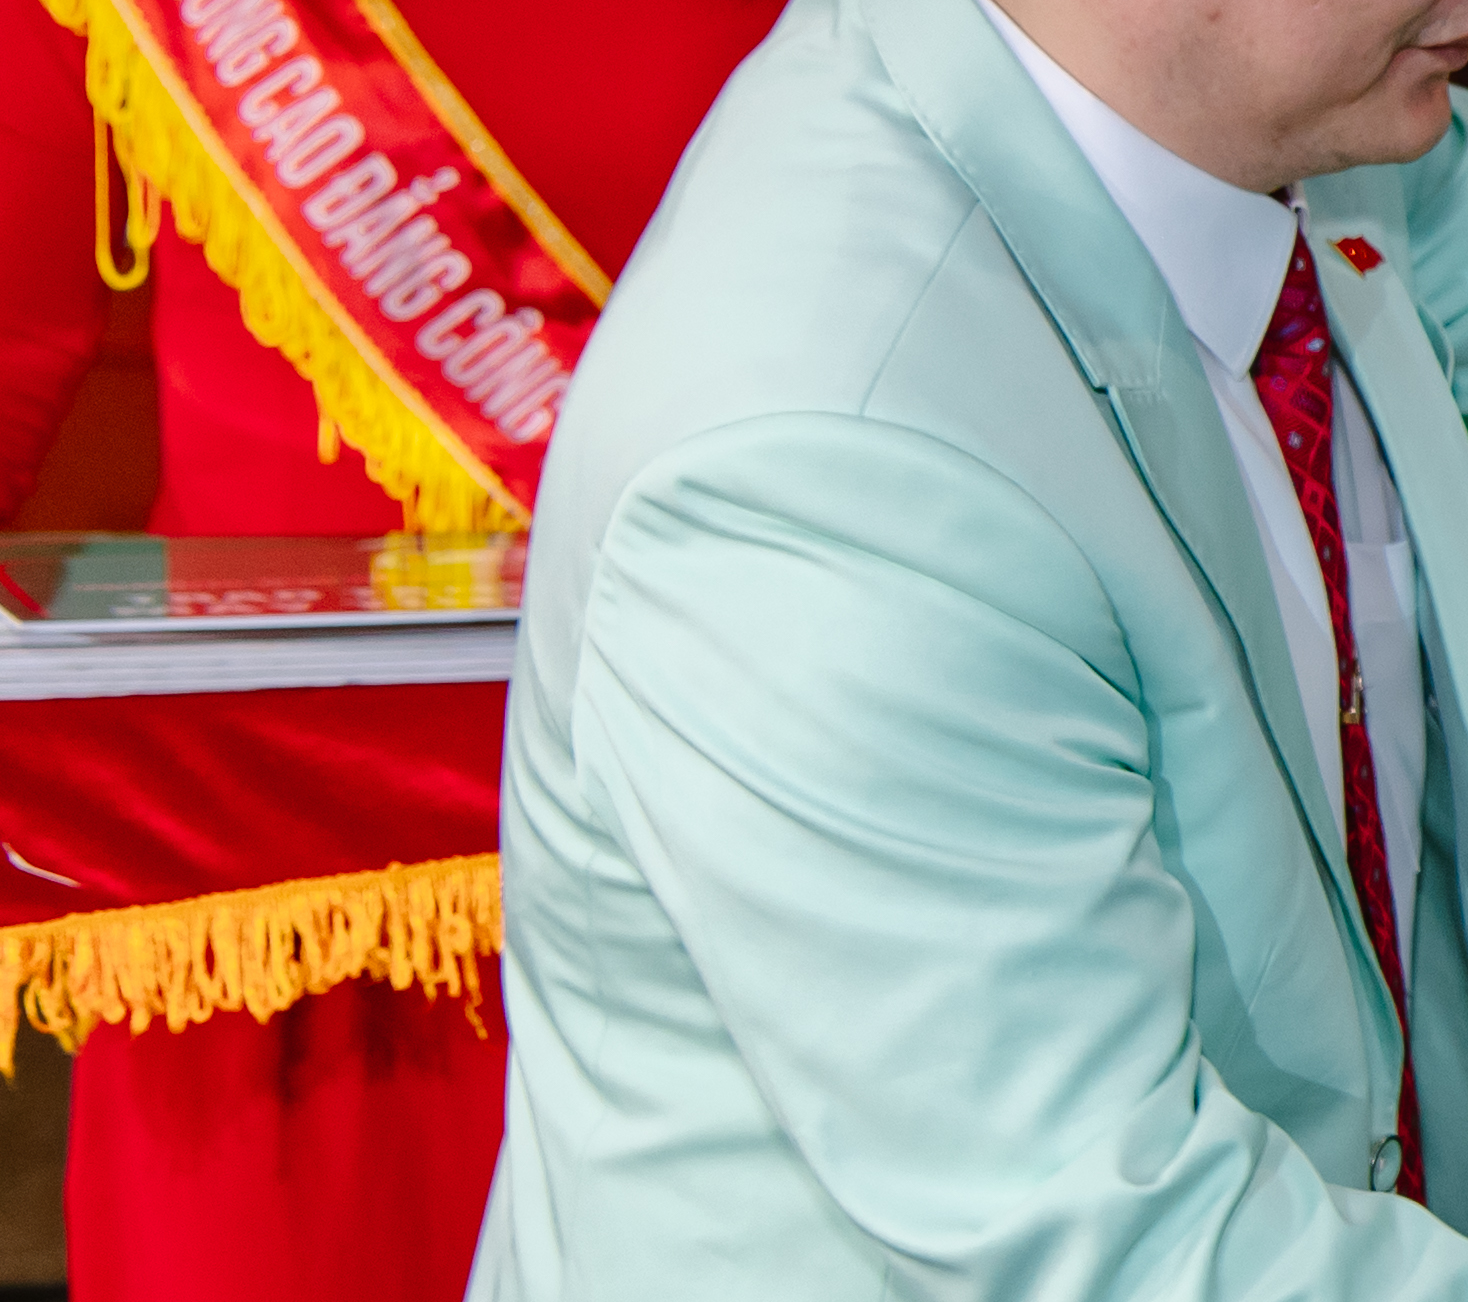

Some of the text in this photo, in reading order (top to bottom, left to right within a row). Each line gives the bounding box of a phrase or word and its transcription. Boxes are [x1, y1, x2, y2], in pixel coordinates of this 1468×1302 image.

[237, 51, 365, 191] CAO
[301, 151, 475, 324] ĐẲNG
[415, 287, 575, 446] CÔNG
